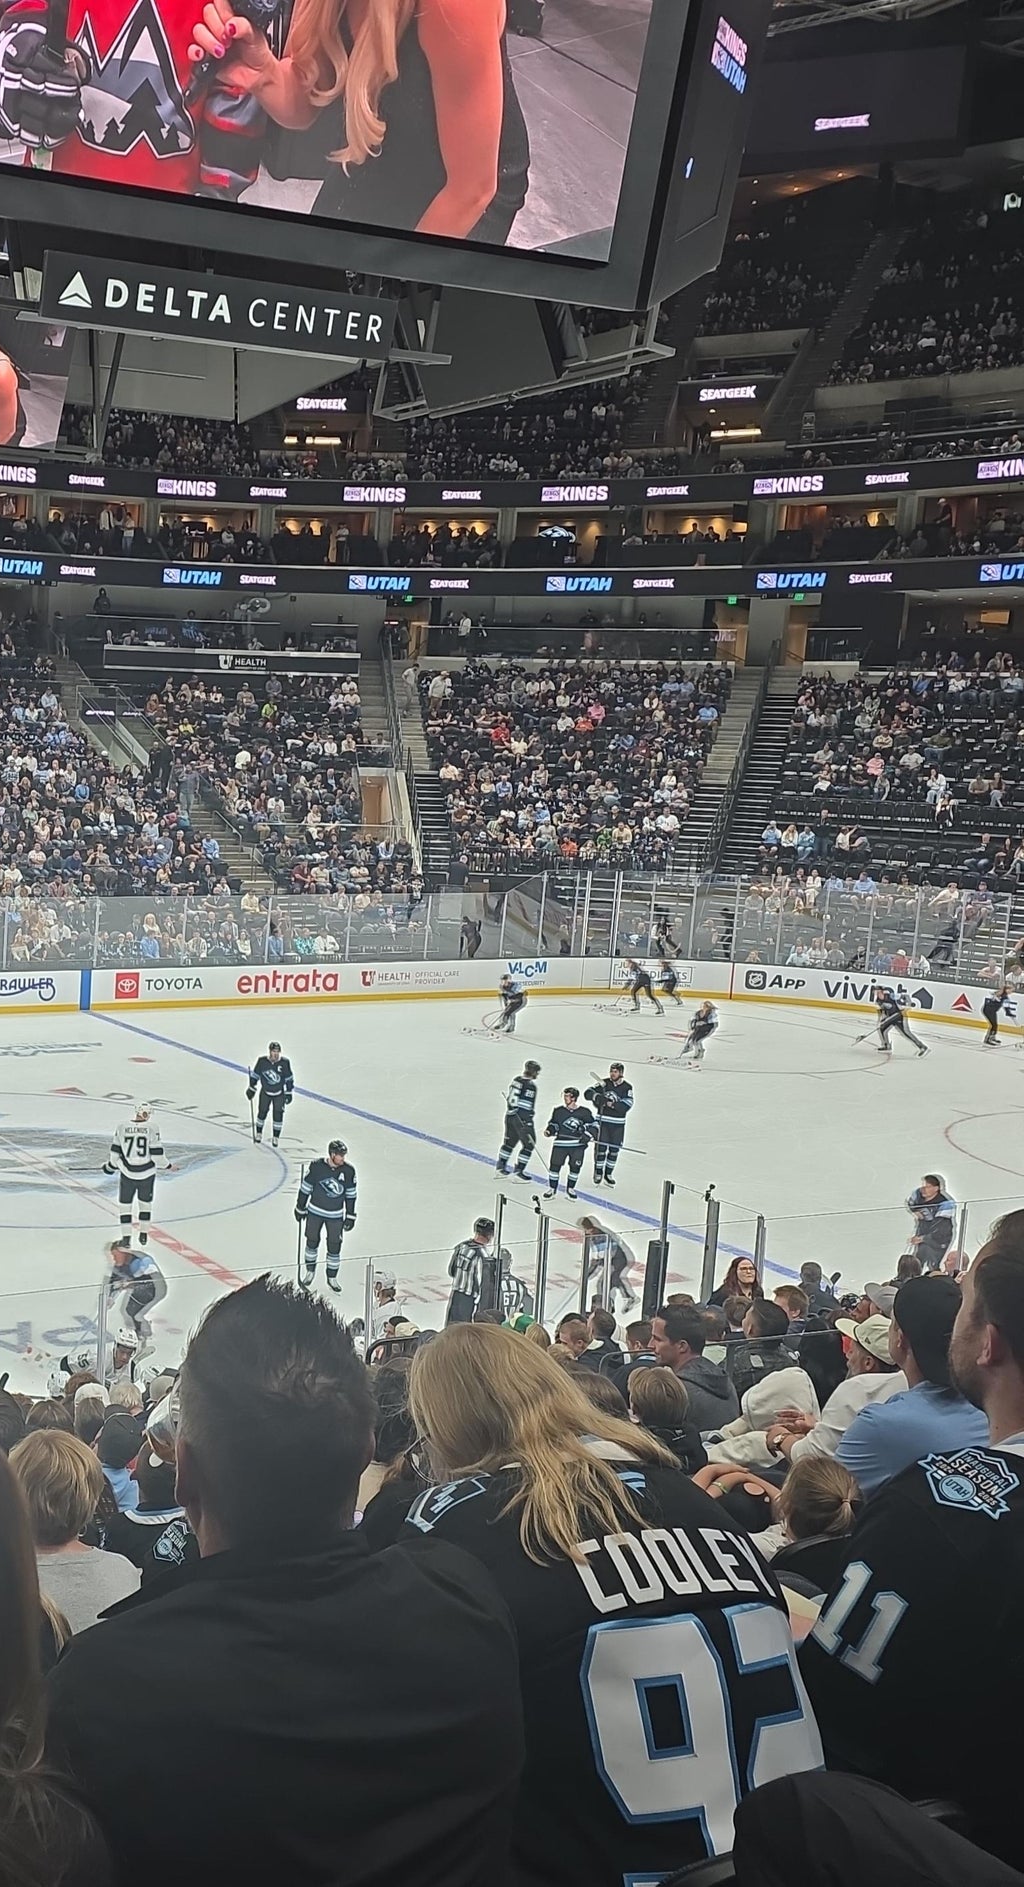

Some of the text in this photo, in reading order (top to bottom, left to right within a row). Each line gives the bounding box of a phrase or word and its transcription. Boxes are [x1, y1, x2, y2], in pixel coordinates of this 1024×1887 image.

[724, 25, 748, 66] KINGS
[724, 57, 747, 94] UTAH
[105, 278, 383, 343] DELTA CENTER
[699, 385, 757, 402] SEATGEEK
[296, 396, 347, 411] SEATGEEK
[998, 458, 1024, 478] KIN
[69, 473, 105, 487] SEATGEEK
[772, 475, 825, 494] KINGS
[865, 471, 910, 486] SEATGEEK
[174, 479, 217, 498] KINGS
[250, 486, 287, 498] SEATGEEK
[360, 486, 406, 503] KINGS
[442, 490, 482, 501] SEATGEEK
[560, 485, 609, 502] KINGS
[646, 485, 690, 498] SEATGEEK
[2, 558, 44, 576] UTAH
[60, 565, 97, 577] SEATGEEK
[1002, 563, 1024, 580] UT
[180, 570, 223, 585] UTAH
[240, 574, 277, 586] SEATGEEK
[367, 576, 412, 591] UTAH
[430, 578, 470, 590] SEATGEEK
[566, 576, 613, 592] UTAH
[633, 578, 676, 589] SEATGEEK
[777, 572, 827, 588] UTAH
[849, 572, 893, 585] SEATGEEK
[235, 657, 267, 667] HEALTH
[145, 977, 203, 991] TOYOTA
[237, 969, 340, 994] entrata
[378, 972, 411, 982] HEALTH
[824, 975, 908, 1007] vivit
[124, 1136, 147, 1158] 79
[338, 1172, 346, 1182] A
[503, 1291, 517, 1306] 67
[950, 1458, 1002, 1496] SEASON
[961, 1453, 1010, 1490] INAUGURAL
[945, 1479, 970, 1498] UTAH
[977, 1491, 998, 1507] 2025
[573, 1527, 778, 1613] COOLEY
[812, 1560, 910, 1685] 11
